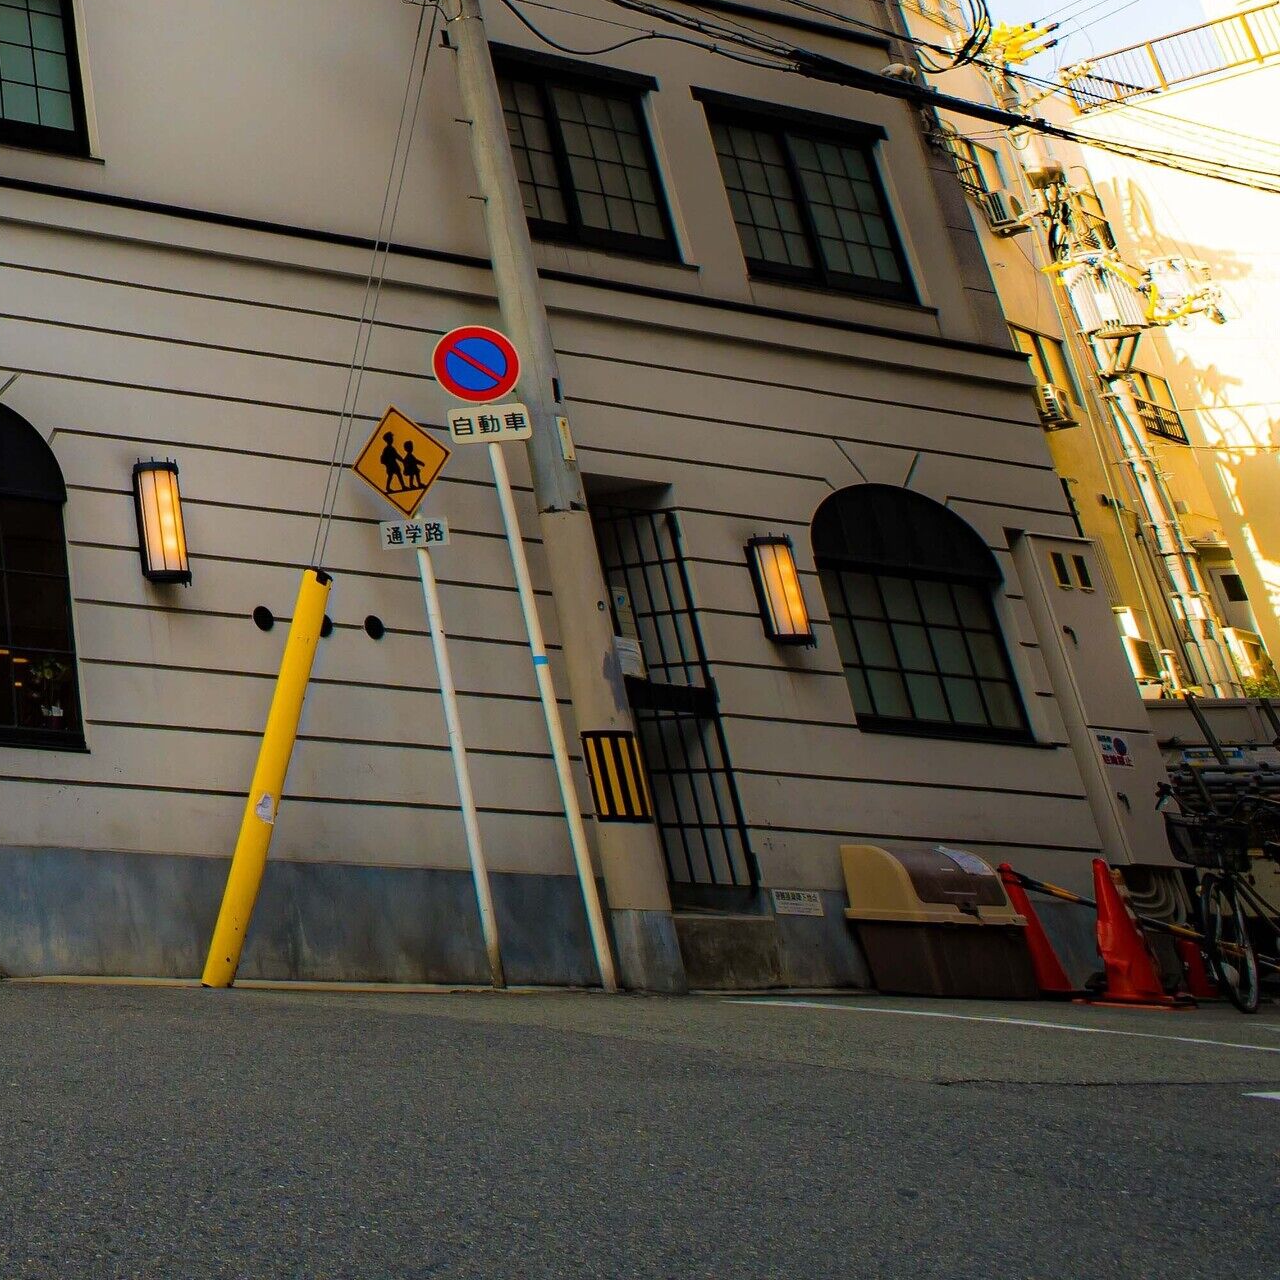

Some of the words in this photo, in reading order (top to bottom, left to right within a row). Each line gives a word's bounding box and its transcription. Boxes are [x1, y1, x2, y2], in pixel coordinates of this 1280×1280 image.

[452, 411, 527, 437] 自動車
[386, 521, 444, 546] 通学路
